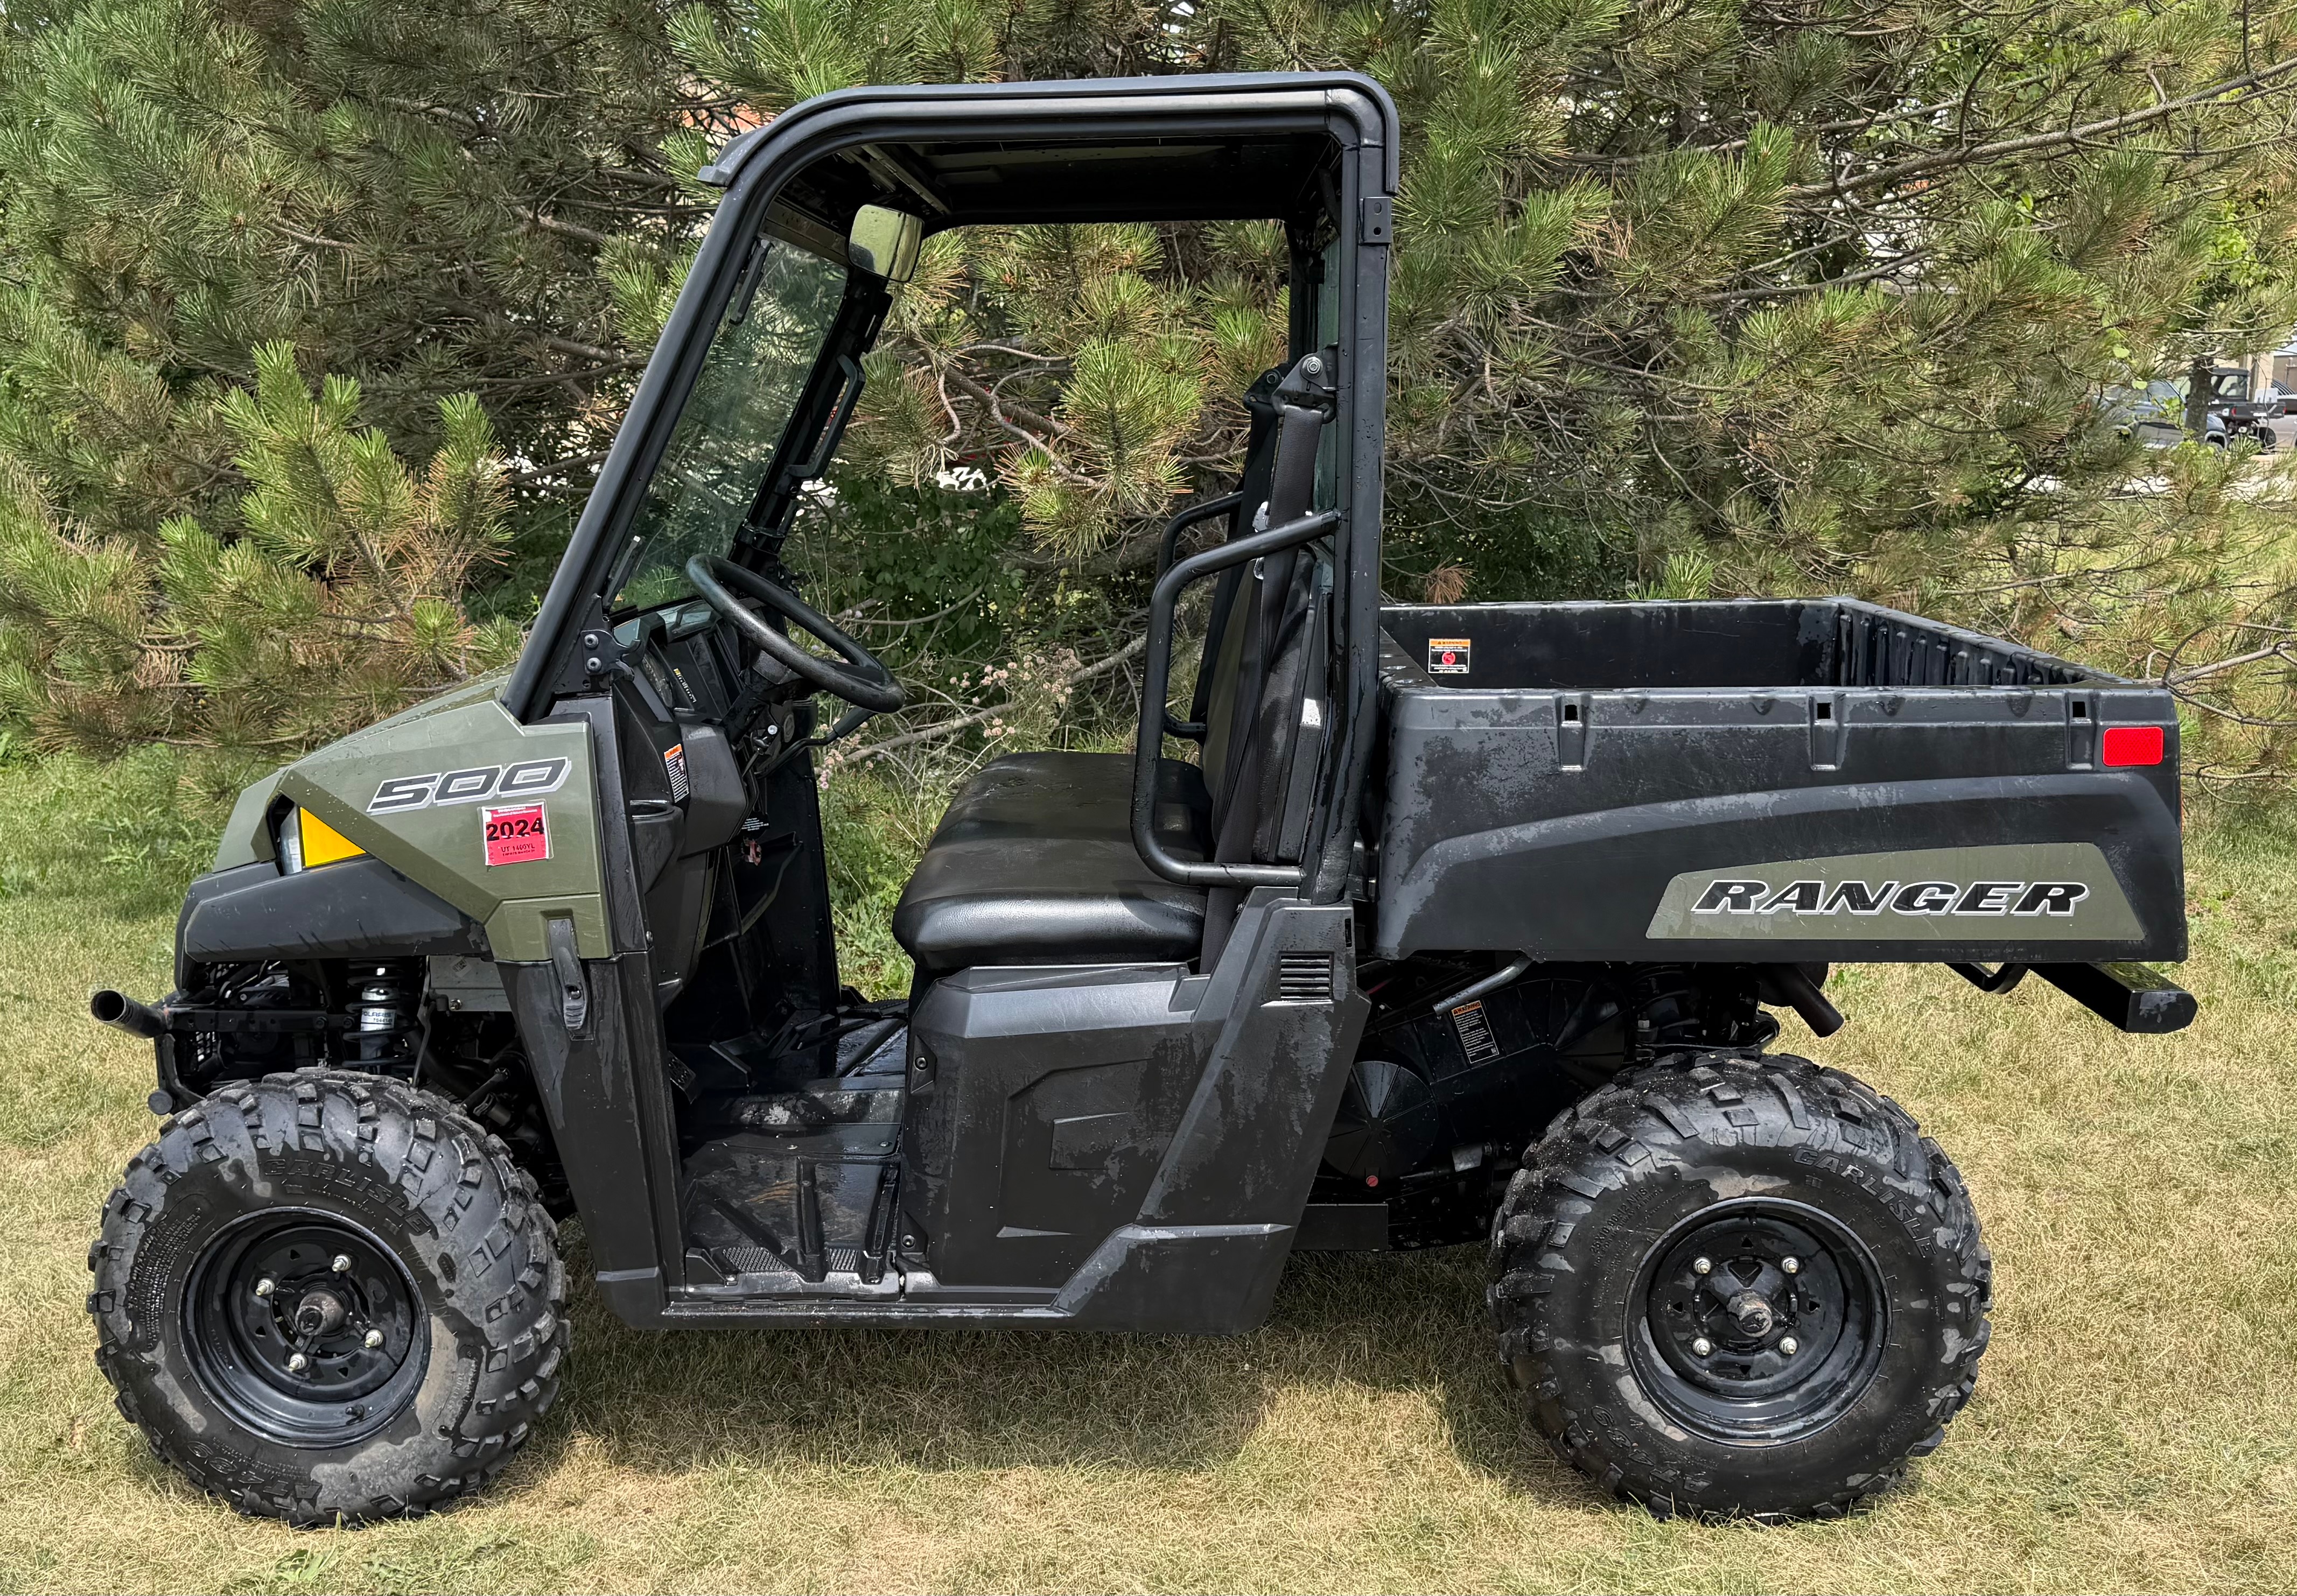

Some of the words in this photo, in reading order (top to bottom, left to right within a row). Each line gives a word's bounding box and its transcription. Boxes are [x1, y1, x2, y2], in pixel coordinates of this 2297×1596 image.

[367, 757, 571, 815] 500
[486, 817, 544, 841] 2024
[1691, 880, 2089, 917] RANGER
[264, 1158, 431, 1234] CARLISLE
[1793, 1147, 1937, 1258] CARLISLE
